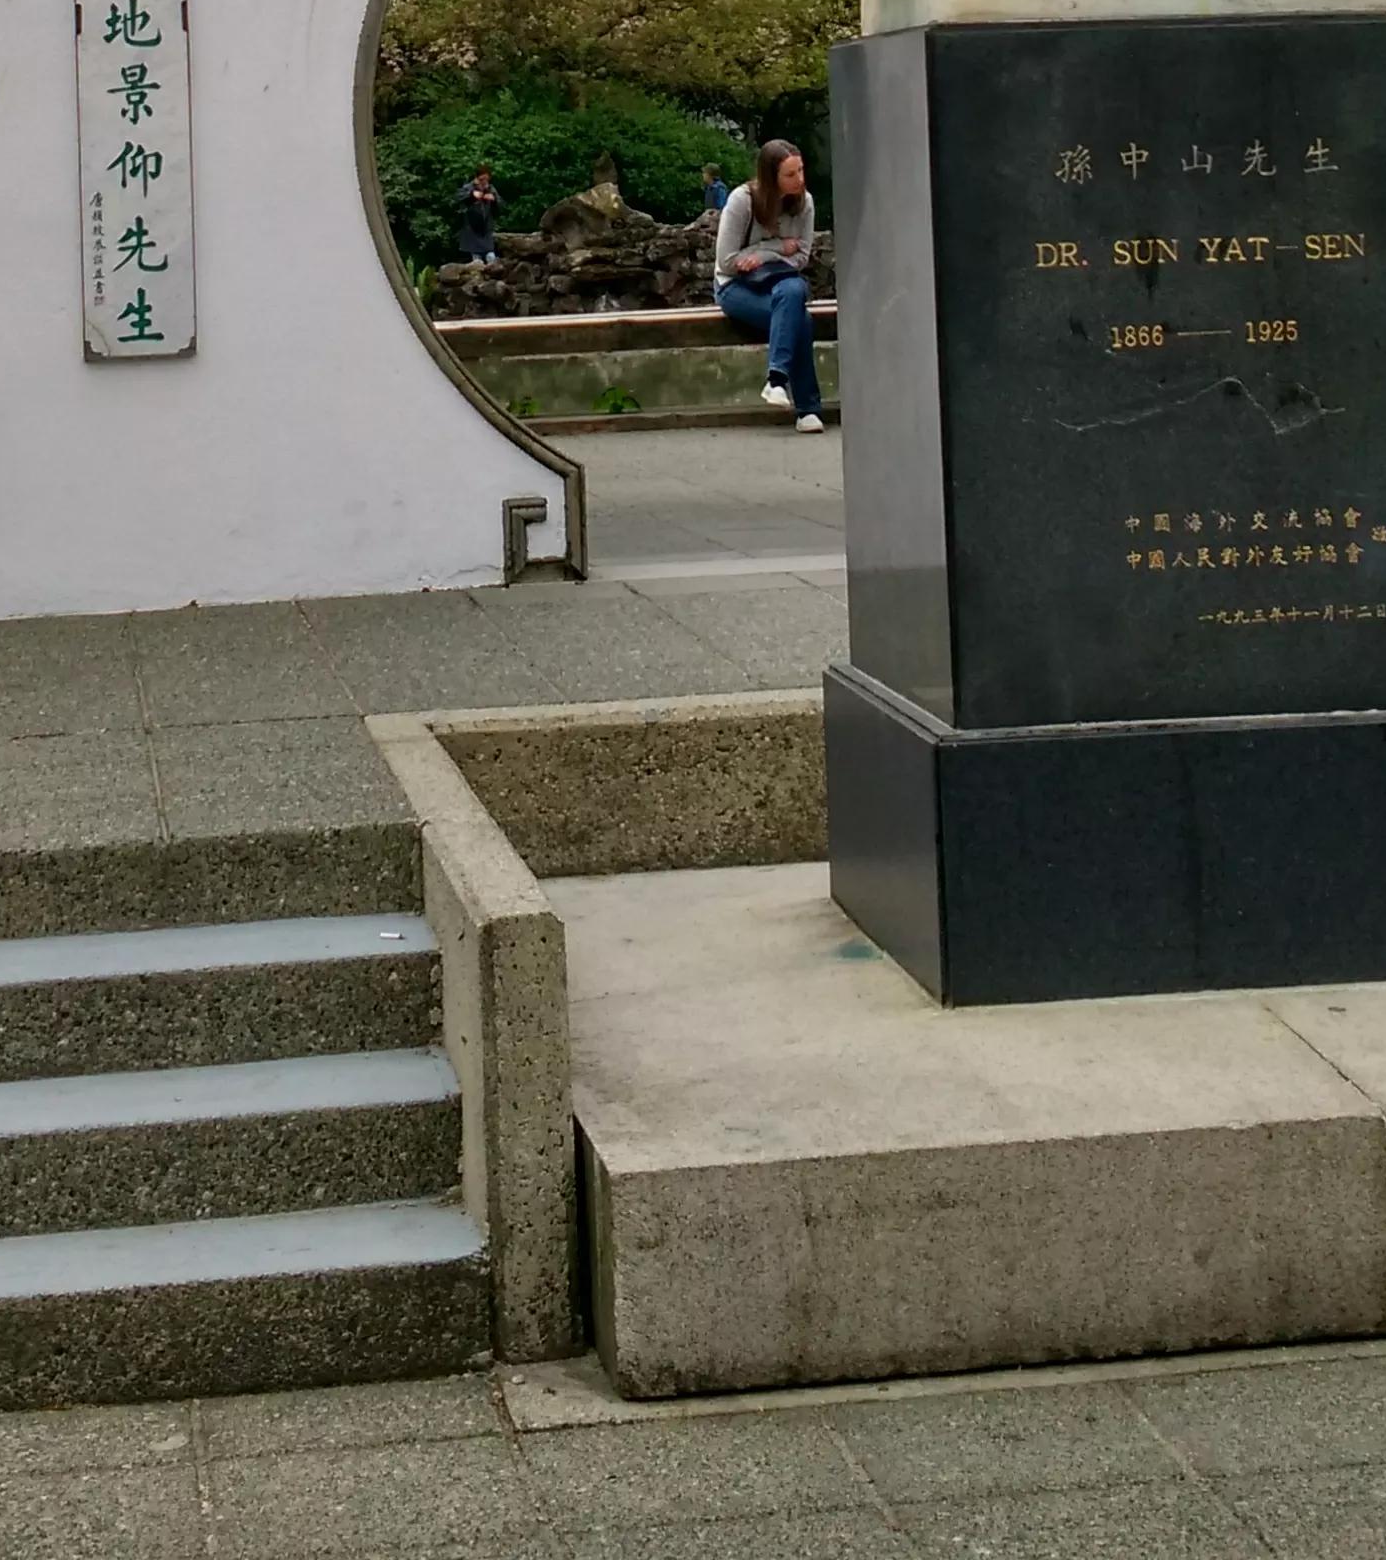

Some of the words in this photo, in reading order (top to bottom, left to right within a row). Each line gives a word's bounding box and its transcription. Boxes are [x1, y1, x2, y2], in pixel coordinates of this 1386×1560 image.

[1054, 137, 1339, 185] 孫中山先生
[1034, 242, 1089, 268] DR.
[1112, 238, 1180, 265] SUN
[1109, 324, 1165, 348] 1866
[1244, 320, 1299, 343] 1925
